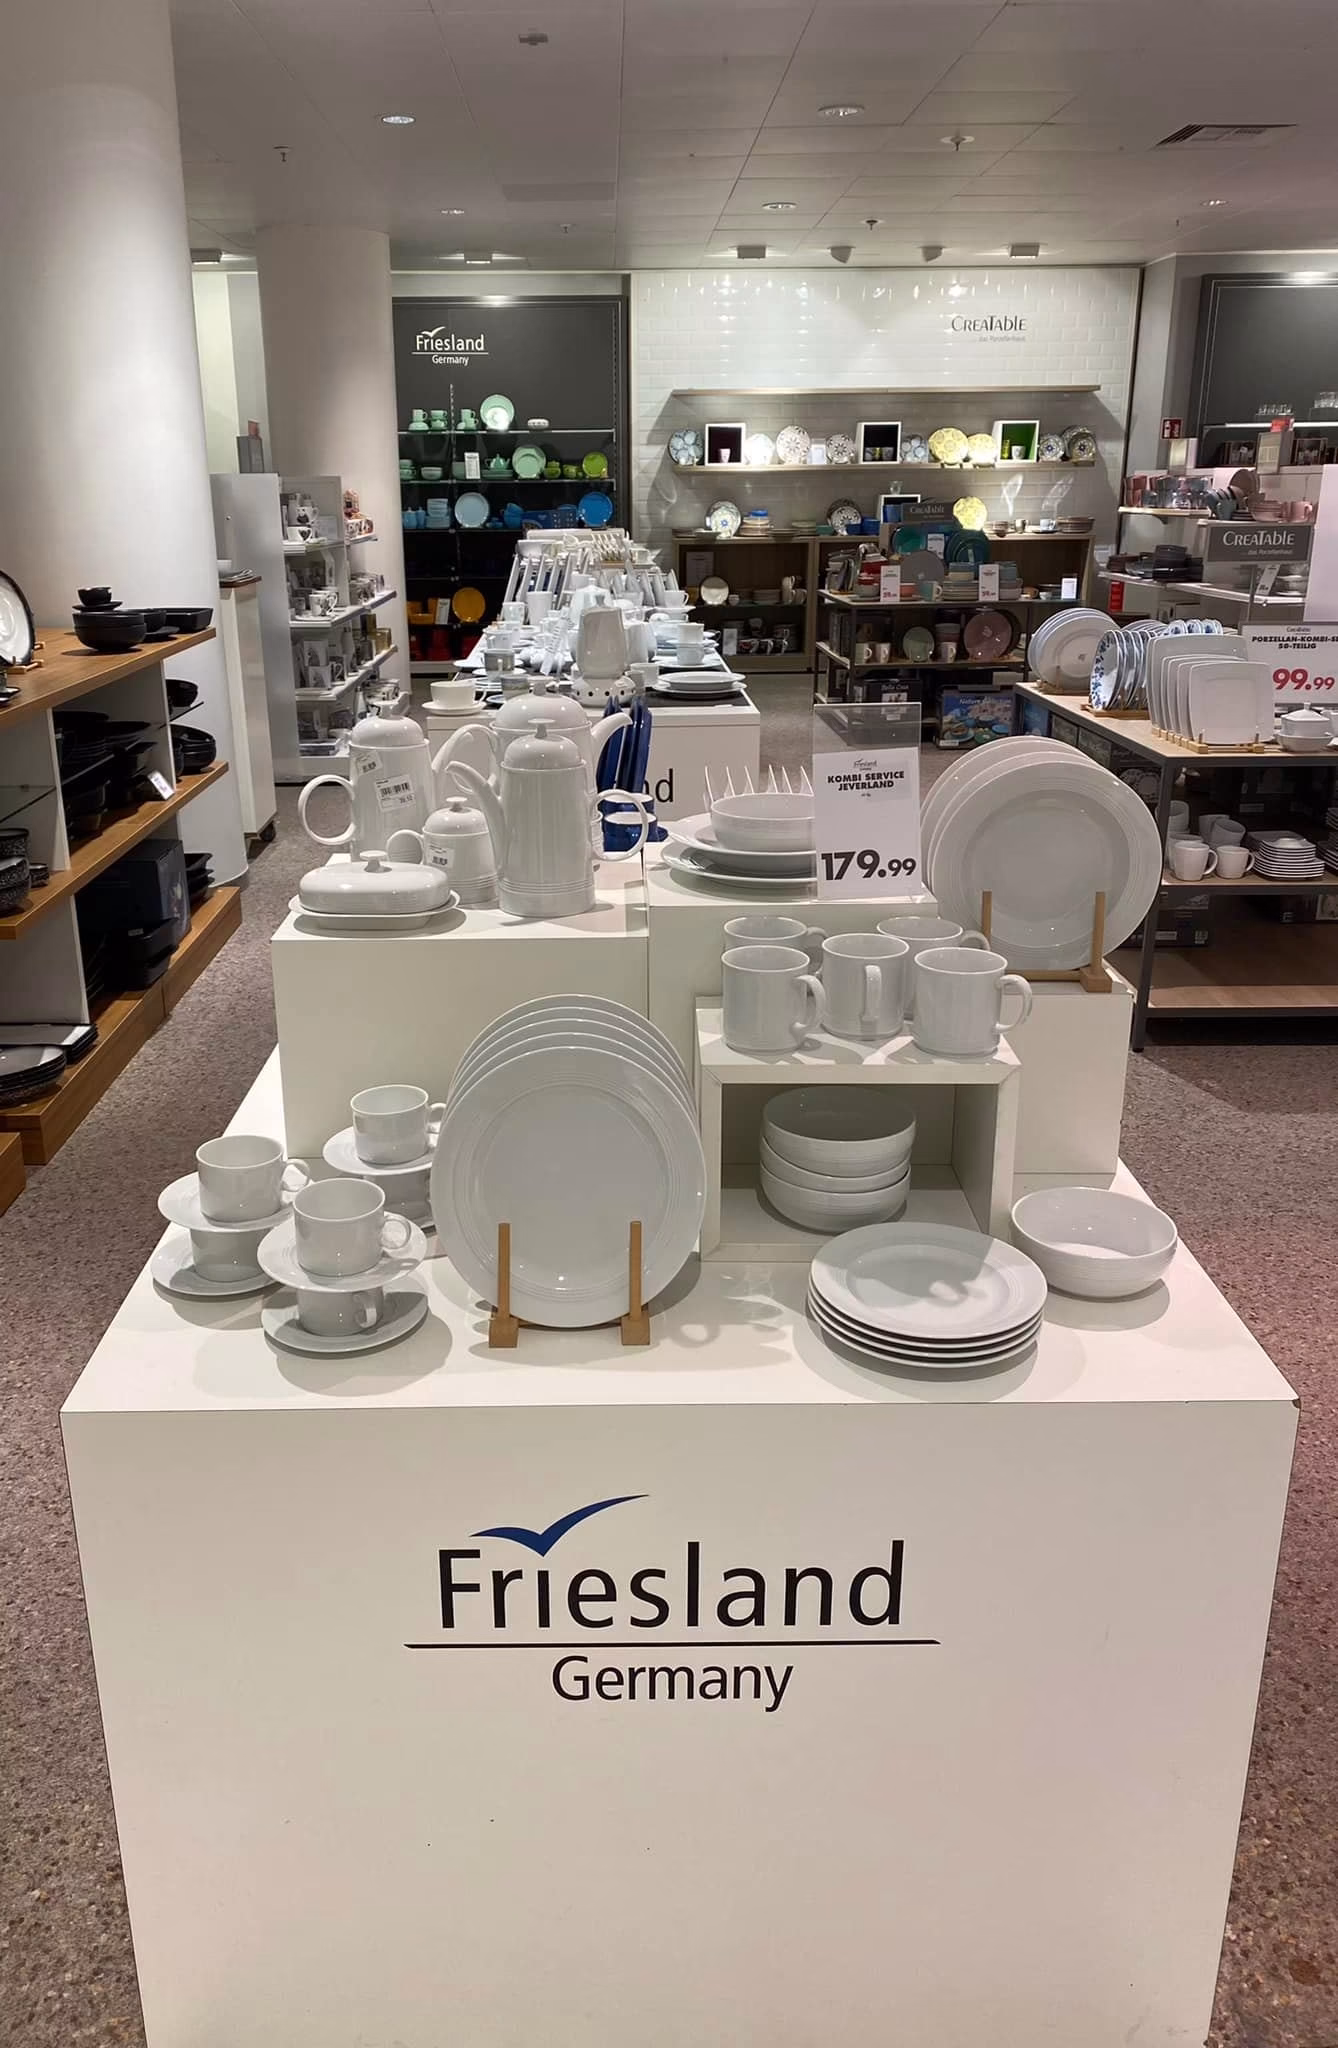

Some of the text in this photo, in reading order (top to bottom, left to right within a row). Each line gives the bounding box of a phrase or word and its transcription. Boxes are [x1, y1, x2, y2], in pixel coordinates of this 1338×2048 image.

[416, 333, 485, 351] Friesland
[431, 354, 469, 367] Germany
[1272, 668, 1336, 691] 99.99
[827, 770, 905, 784] KOMBI SERVICE
[838, 780, 895, 792] JEVERLAND
[820, 849, 917, 881] 179.99
[438, 1539, 905, 1629] Friesland
[551, 1655, 794, 1712] Germany
